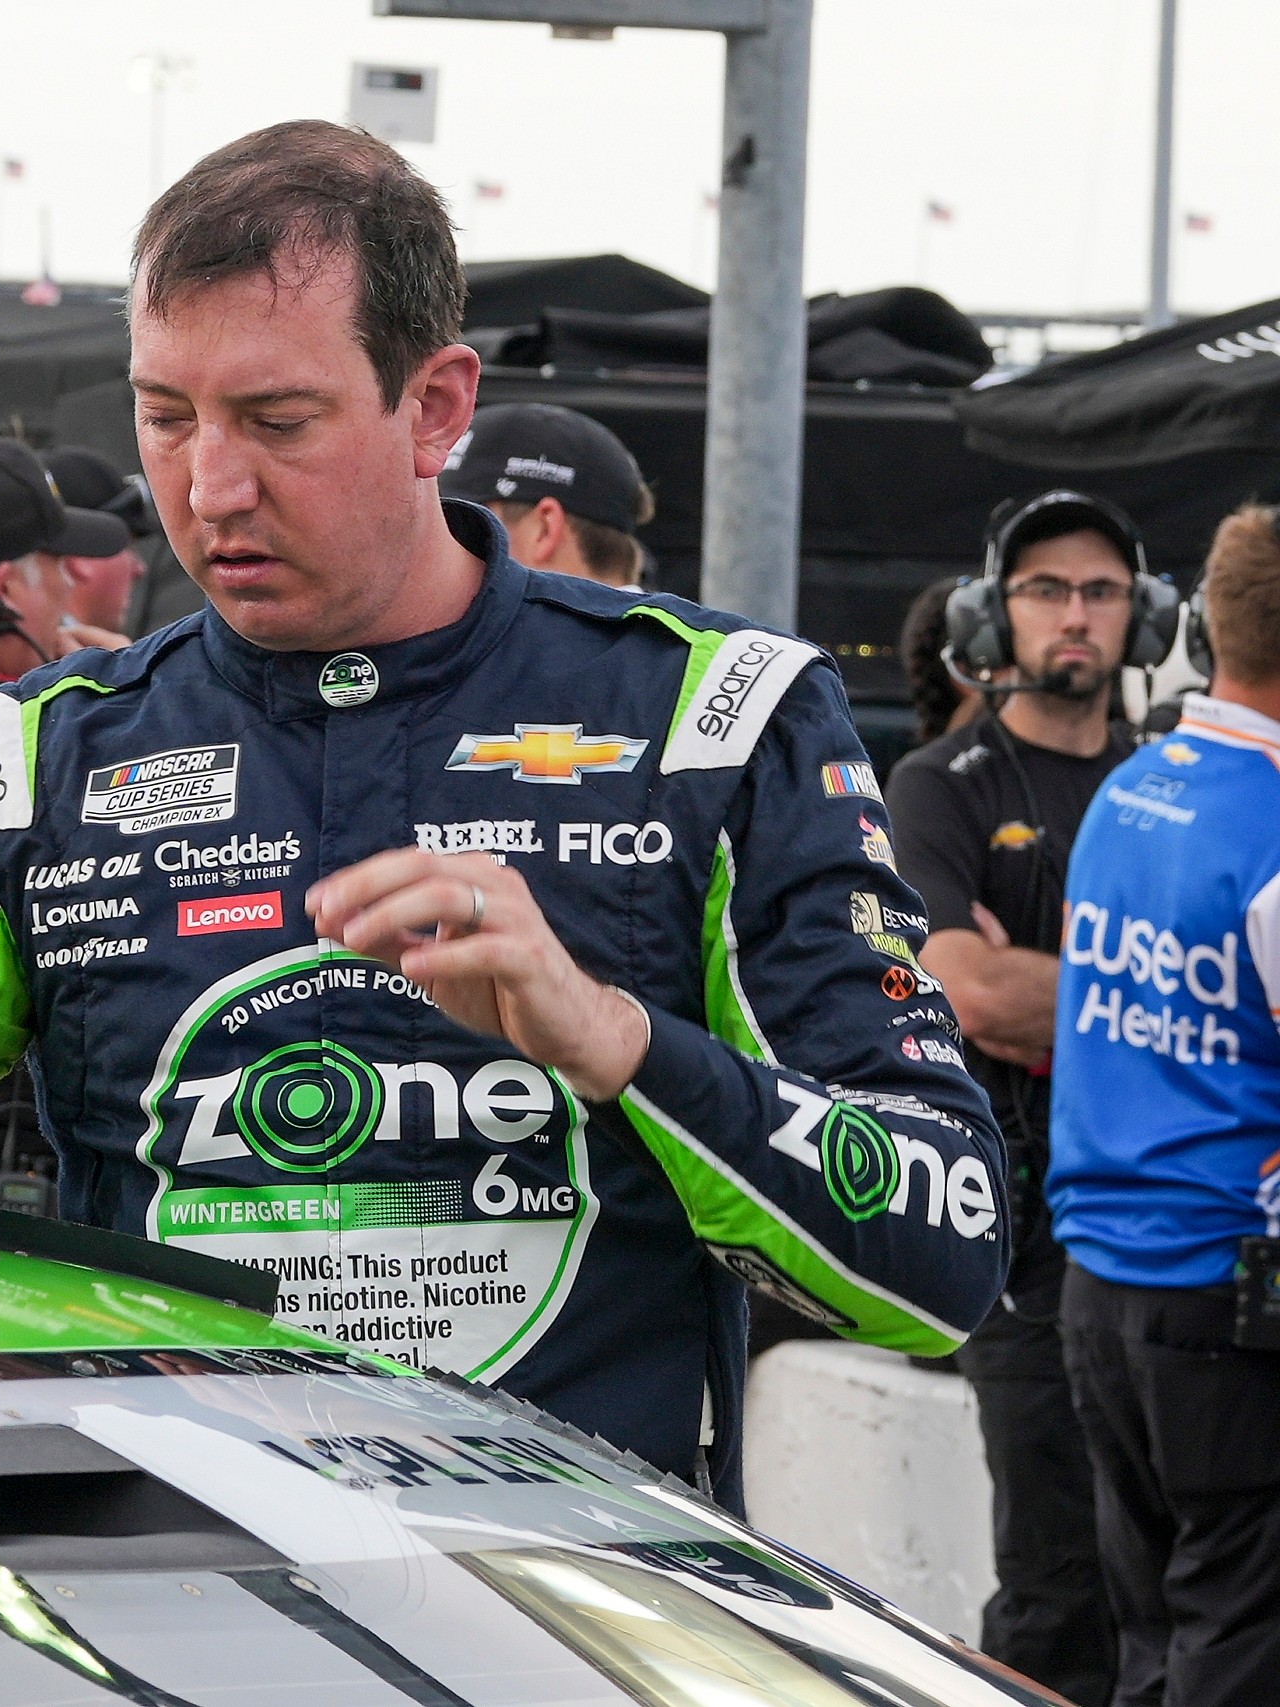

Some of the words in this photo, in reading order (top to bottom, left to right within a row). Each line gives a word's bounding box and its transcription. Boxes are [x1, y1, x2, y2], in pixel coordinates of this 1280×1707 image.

[697, 641, 776, 739] sparco
[133, 751, 216, 782] NASCAR
[106, 790, 145, 811] CUP
[147, 778, 214, 804] SERIES
[131, 810, 202, 831] CHAMPION
[204, 806, 223, 819] 2X
[154, 831, 301, 872] Cheddar's
[414, 819, 545, 856] REBEL
[558, 820, 673, 866] FICO
[24, 858, 96, 890] LUCAS
[100, 852, 142, 879] OIL
[169, 872, 219, 888] SCRATCH
[244, 865, 291, 881] KITCHEN
[186, 904, 274, 928] Lenovo
[221, 1006, 250, 1035] 20
[249, 968, 367, 1015] NICOTINE
[372, 971, 443, 1009] POUC
[174, 1040, 554, 1173] zone
[769, 1077, 997, 1240] zone
[472, 1154, 519, 1216] 6
[522, 1186, 574, 1212] MG
[170, 1199, 341, 1225] WINTERGREEN
[227, 1254, 342, 1281] ARNING:
[347, 1253, 402, 1280] This
[410, 1248, 508, 1281] product
[308, 1286, 416, 1313] nicotine.
[423, 1280, 527, 1308] Nicotine
[336, 1315, 453, 1343] addictive
